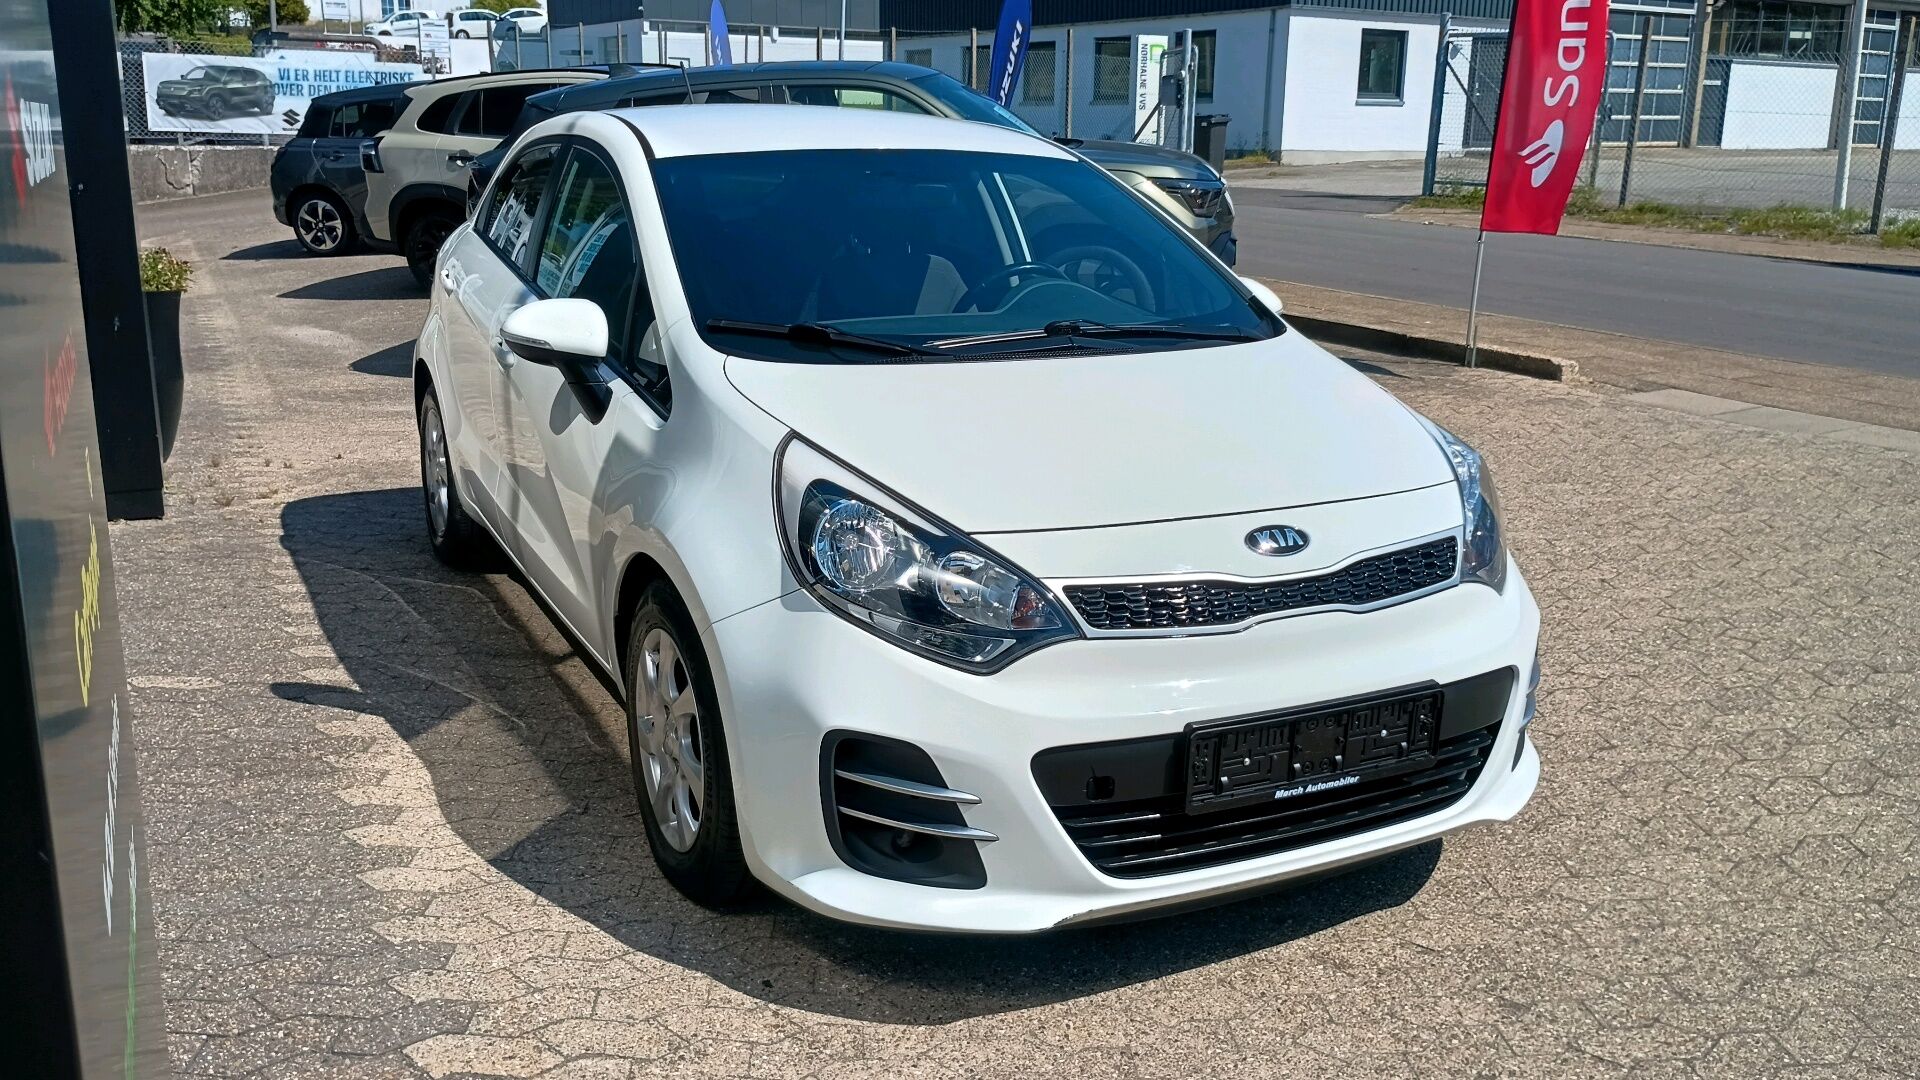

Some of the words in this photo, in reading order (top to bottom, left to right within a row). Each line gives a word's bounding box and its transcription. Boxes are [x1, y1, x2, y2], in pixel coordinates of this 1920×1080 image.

[998, 20, 1023, 106] UZUKI
[278, 68, 290, 81] VI
[295, 68, 309, 82] ER
[313, 69, 341, 83] HELT
[273, 83, 304, 97] OVER
[1138, 93, 1147, 111] VVS
[1253, 528, 1304, 549] KIA
[1305, 775, 1360, 793] Automobiler
